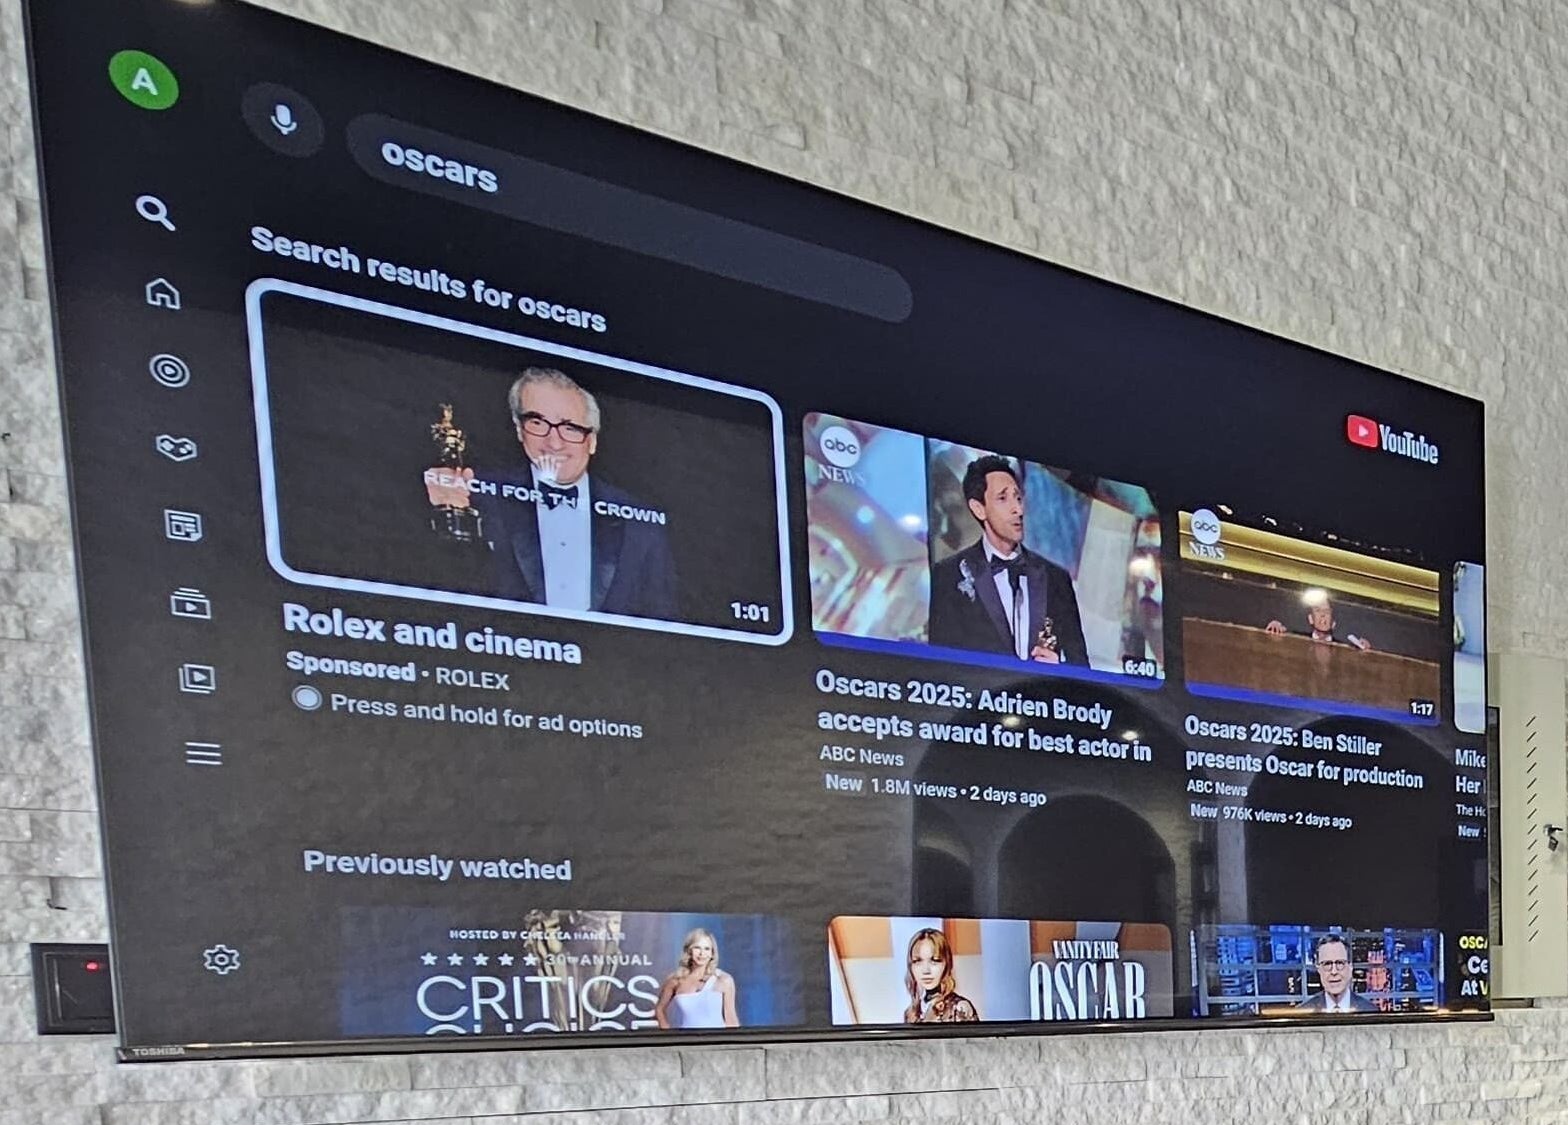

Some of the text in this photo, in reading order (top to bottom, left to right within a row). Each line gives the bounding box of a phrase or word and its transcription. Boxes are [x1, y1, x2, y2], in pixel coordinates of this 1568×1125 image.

[131, 67, 158, 96] A
[381, 142, 498, 193] oscars
[251, 226, 607, 332] Search results for oscars
[824, 438, 857, 455] abc
[1379, 423, 1439, 465] YouTube
[423, 470, 497, 496] REACH
[502, 484, 544, 503] FOR
[594, 501, 666, 525] CROWN
[731, 602, 769, 622] 1:01
[283, 602, 583, 665] Rolex and cinema
[286, 651, 511, 691] Sponsored ROLEX
[1125, 660, 1155, 677] 6:40
[815, 668, 1113, 731] Oscars 2025: Adrien Brody
[1411, 702, 1433, 716] 1:17
[331, 693, 644, 738] Press and hold for ad options
[817, 709, 1153, 763] accepts award for best actor in
[1184, 714, 1382, 757] Oscars 2025: Ben Stiller
[819, 745, 905, 767] ABC News
[1186, 750, 1424, 790] presents Oscar for production
[825, 773, 1048, 807] New 1.8M views 2 days ago
[1186, 779, 1248, 797] ABC News
[1455, 775, 1481, 794] Her
[1190, 803, 1353, 830] New 976K views 2 days ago
[1456, 803, 1474, 816] The
[1458, 825, 1480, 838] New
[303, 850, 572, 881] Previously watched
[450, 930, 499, 941] HOSTED
[502, 930, 518, 941] BY
[1052, 940, 1120, 960] VANITY FAIR
[416, 975, 661, 1023] CRITICS
[1029, 960, 1146, 1021] OSCAR
[1461, 980, 1478, 996] At
[131, 1047, 186, 1057] TOSHIBA
